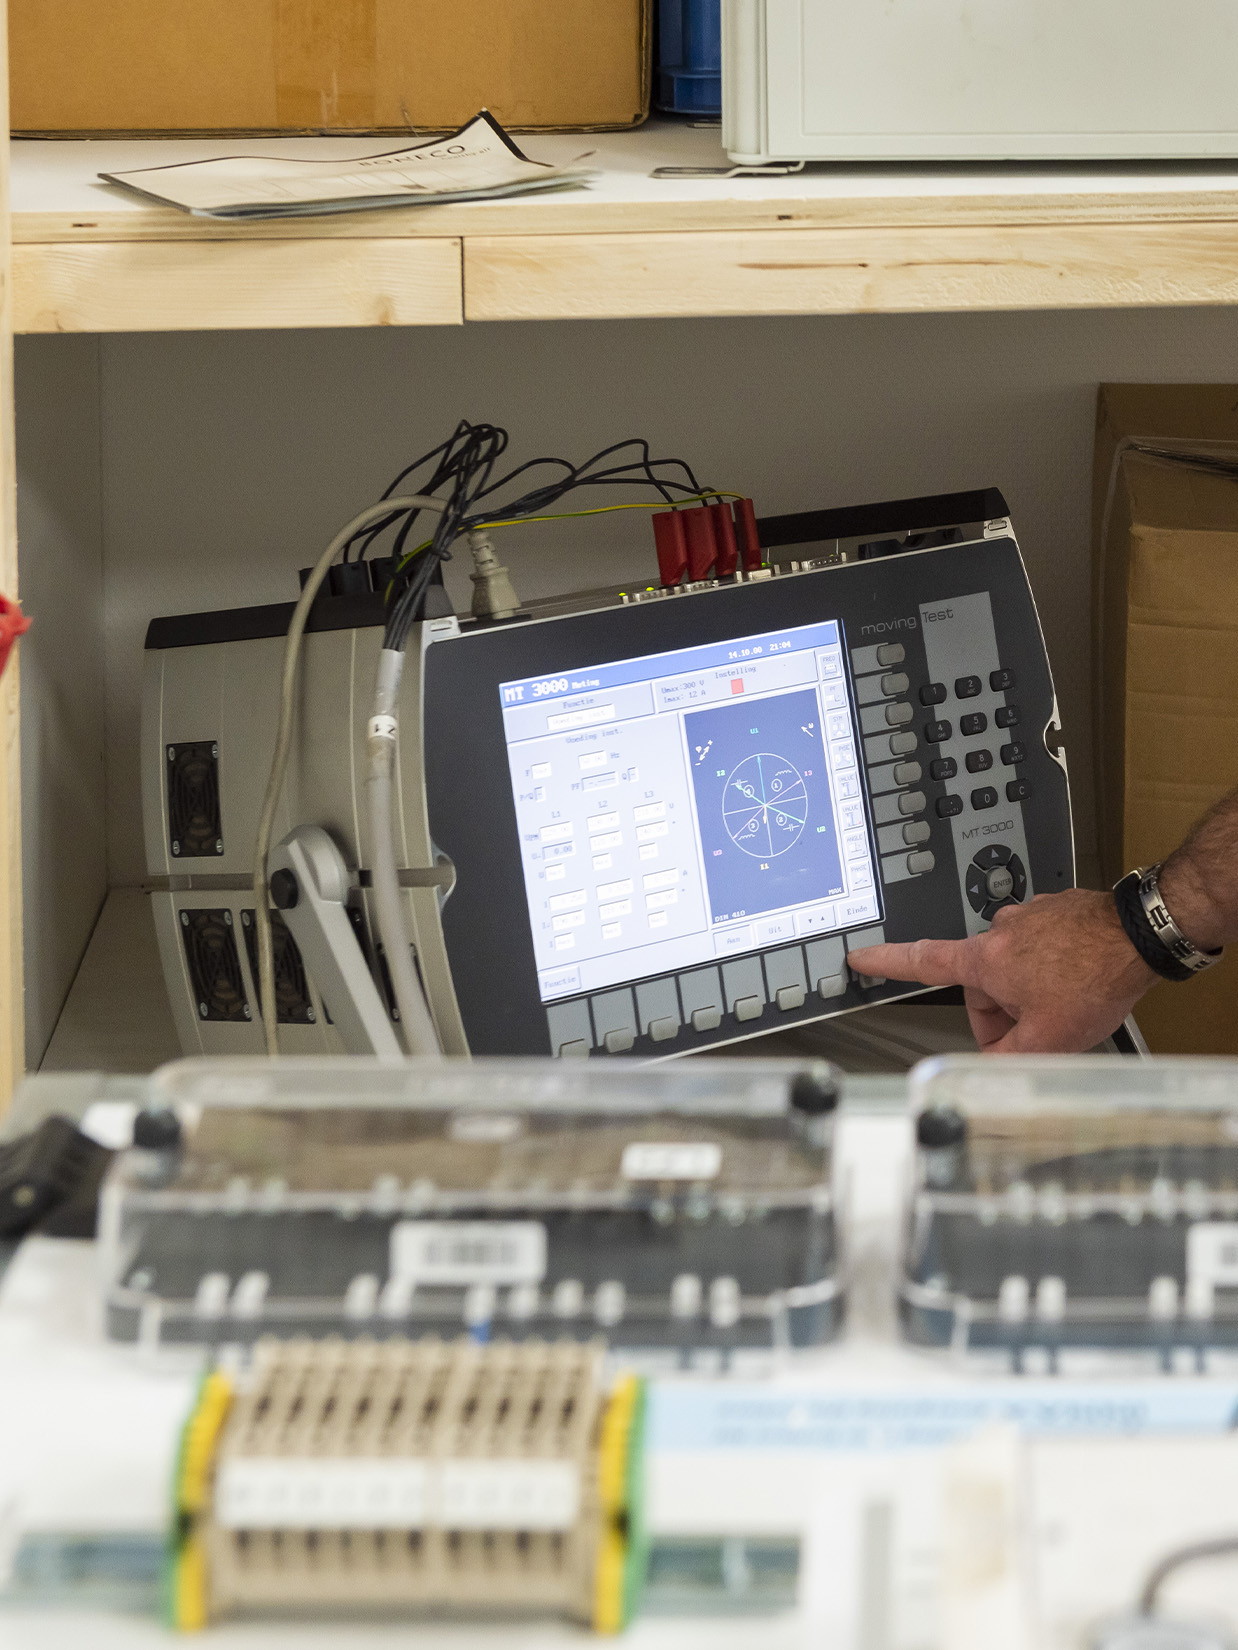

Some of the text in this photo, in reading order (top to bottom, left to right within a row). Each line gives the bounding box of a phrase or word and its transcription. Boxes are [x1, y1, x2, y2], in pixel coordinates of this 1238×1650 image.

[358, 145, 465, 167] BONECO
[861, 608, 954, 636] moving Test
[715, 666, 757, 679] Instelling
[1003, 672, 1009, 680] 3
[968, 680, 974, 688] 2
[504, 686, 524, 702] MT
[531, 678, 569, 697] 3000
[689, 691, 699, 699] 12
[701, 688, 707, 696] A
[933, 687, 937, 695] 1
[1008, 710, 1014, 718] 6
[973, 716, 979, 724] 5
[938, 724, 943, 732] 4
[1013, 746, 1019, 754] 9
[979, 754, 985, 762] 8
[944, 762, 949, 770] 7
[1019, 786, 1025, 795] C
[644, 791, 654, 799] L3
[598, 800, 608, 808] L2
[962, 820, 1014, 840] MT 3000
[993, 878, 1012, 889] ENTER
[846, 905, 868, 916] Einde
[768, 926, 782, 935] Uit
